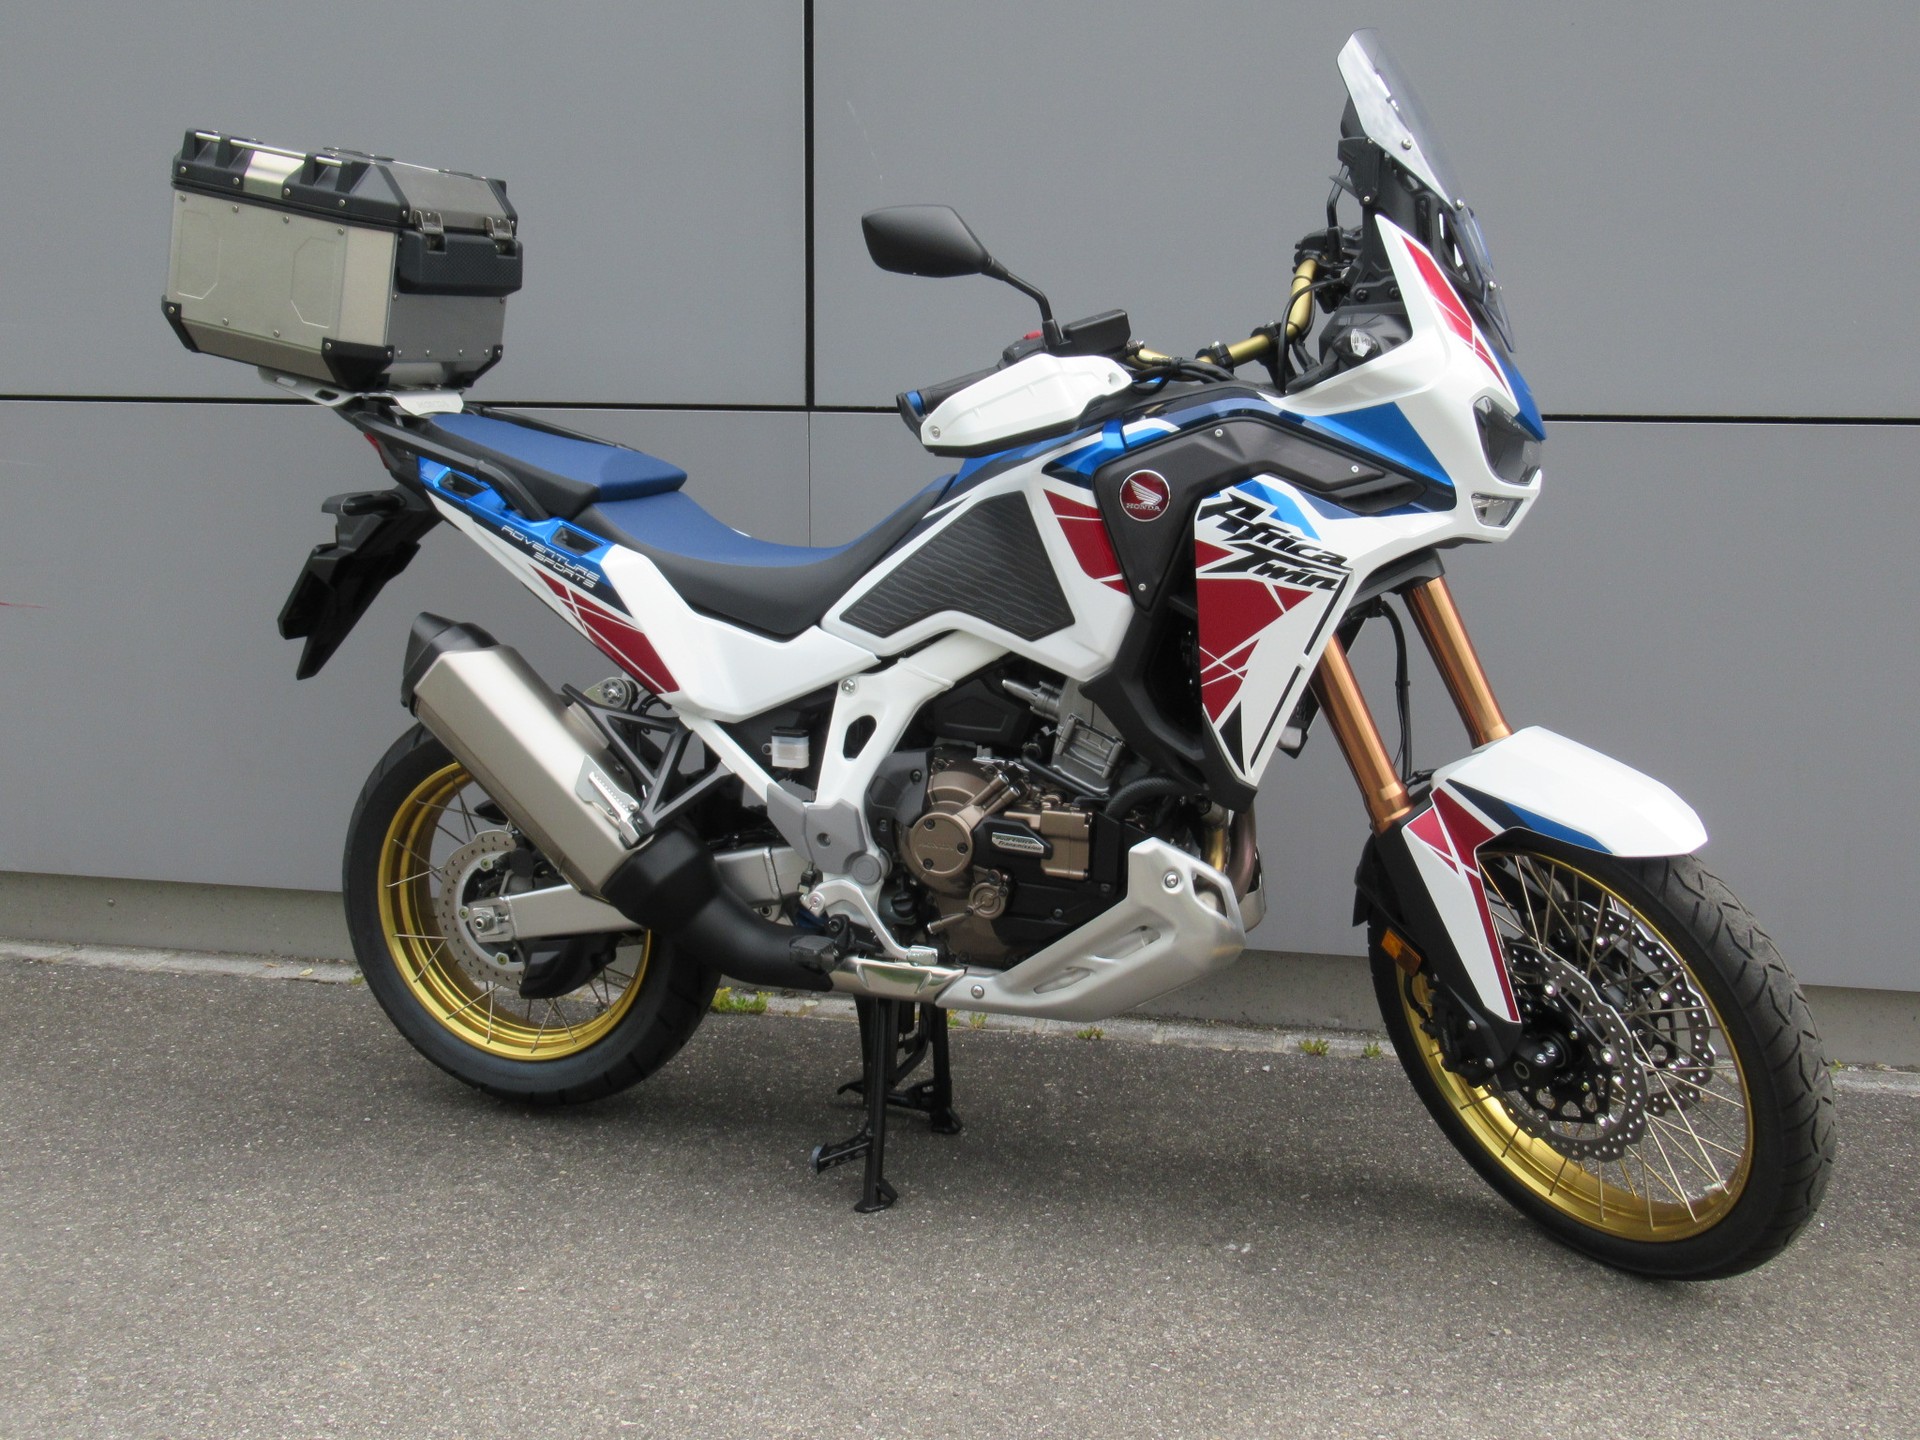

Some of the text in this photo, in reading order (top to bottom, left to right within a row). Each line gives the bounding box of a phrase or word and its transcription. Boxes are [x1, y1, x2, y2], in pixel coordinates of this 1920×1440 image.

[1126, 502, 1162, 512] HONDA
[500, 524, 600, 582] ADVENTURE
[1197, 493, 1353, 571] Africa
[532, 551, 597, 589] SPORTS
[1200, 542, 1351, 591] Twin
